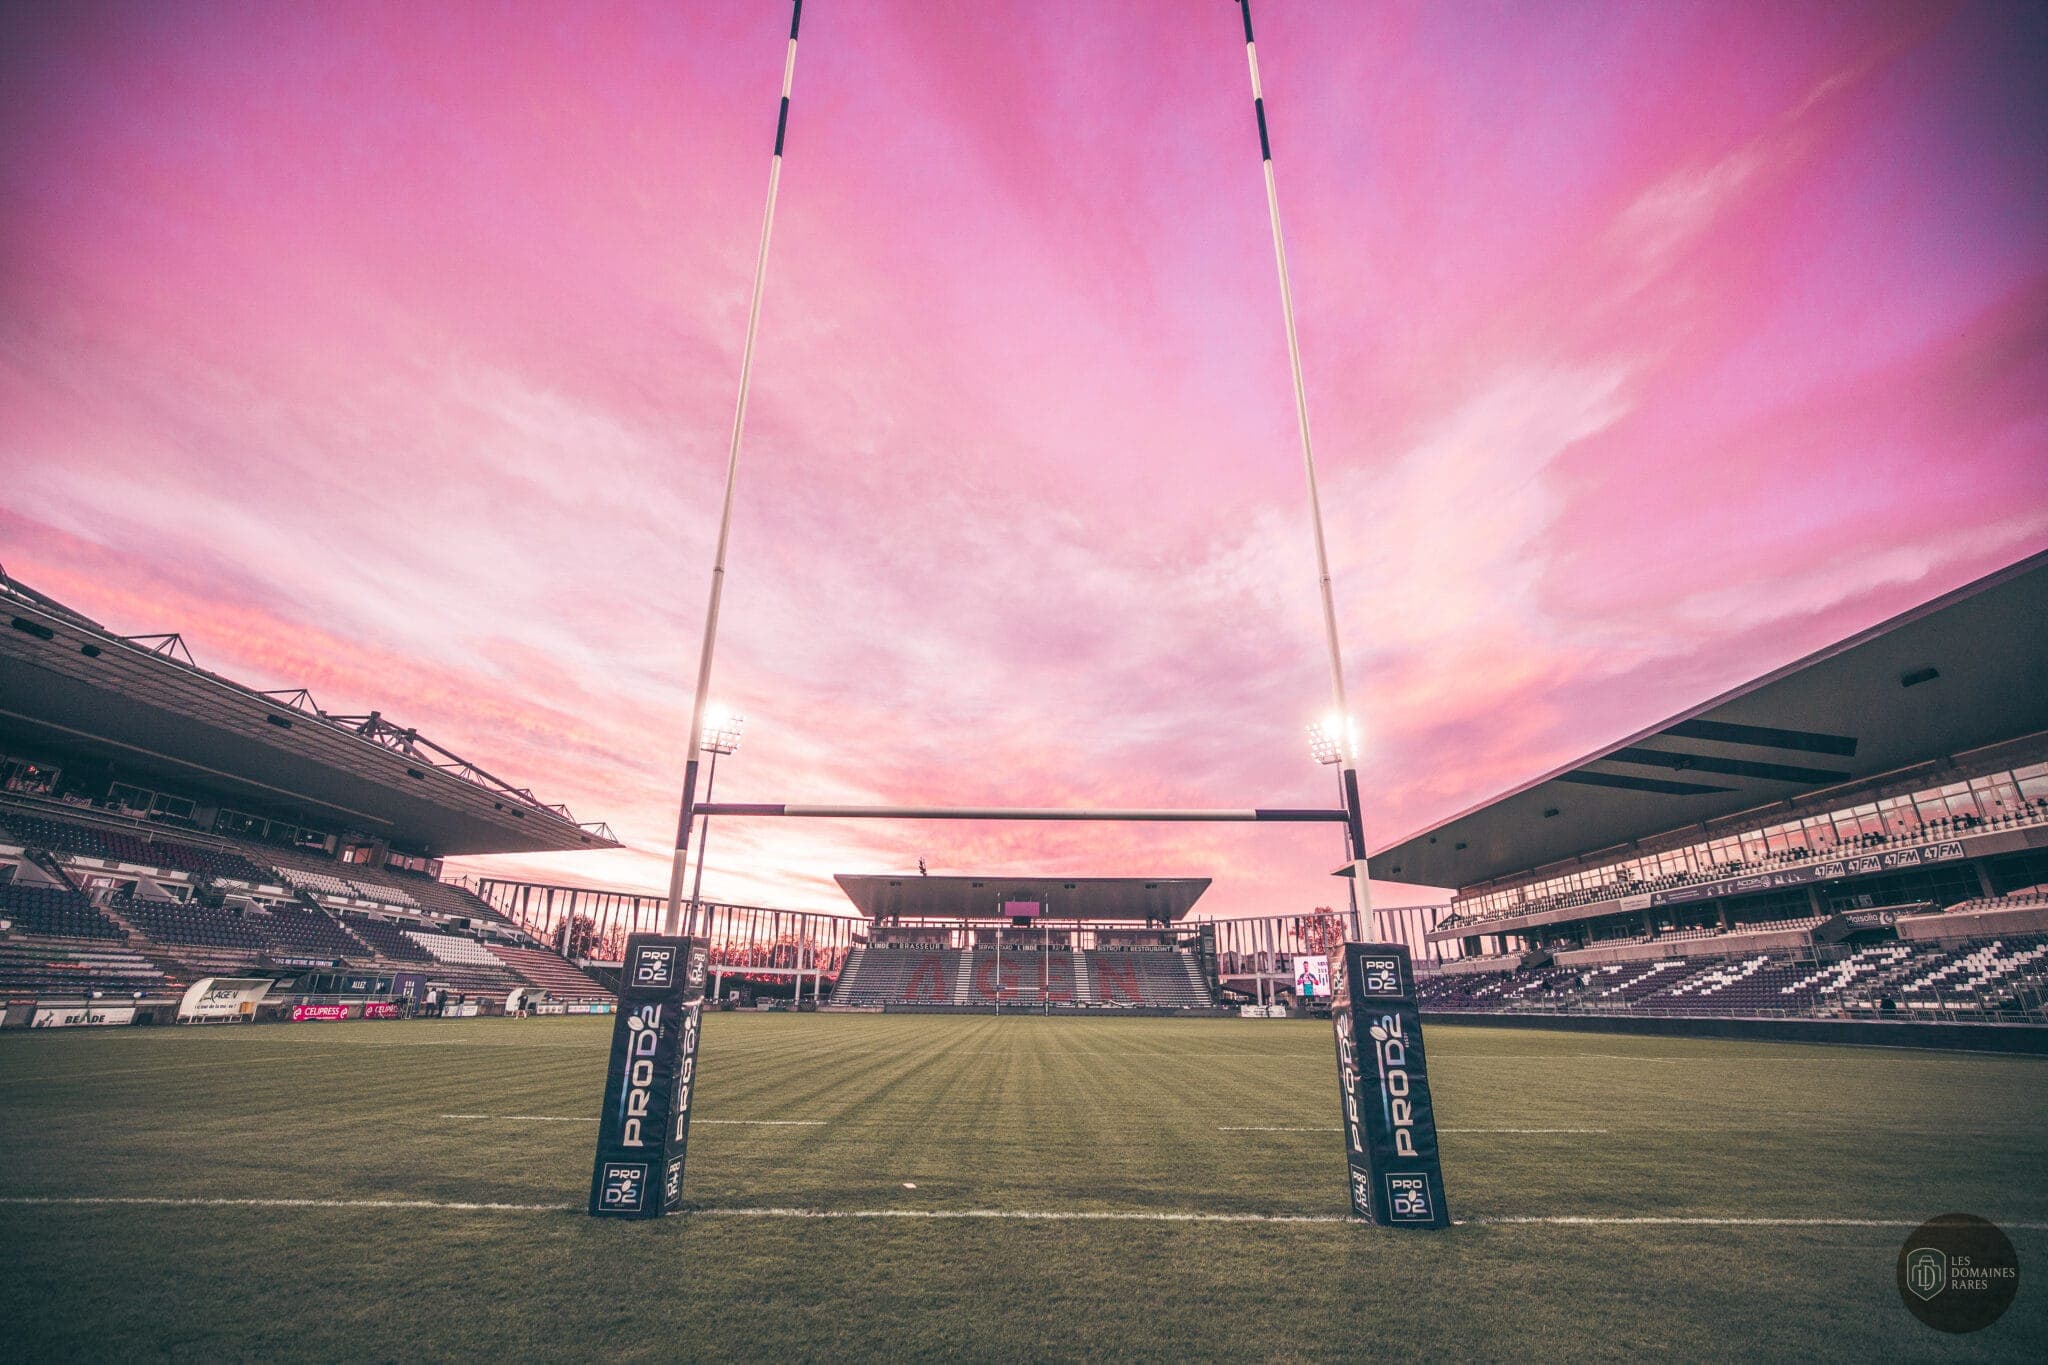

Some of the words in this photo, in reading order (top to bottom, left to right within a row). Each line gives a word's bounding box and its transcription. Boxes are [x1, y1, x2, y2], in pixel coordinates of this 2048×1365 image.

[1940, 843, 1961, 856] FM
[1899, 850, 1918, 862] FM
[1862, 857, 1878, 868] FM
[1827, 863, 1843, 874] FM
[642, 952, 670, 960] PRO
[1366, 961, 1394, 969] PRO
[639, 968, 667, 980] D2
[1368, 978, 1397, 990] D2
[305, 1007, 339, 1015] CELIPRESS
[609, 1170, 640, 1178] PRO
[1392, 1180, 1422, 1188] PRO
[606, 1188, 636, 1202] D2
[1395, 1199, 1427, 1213] D2
